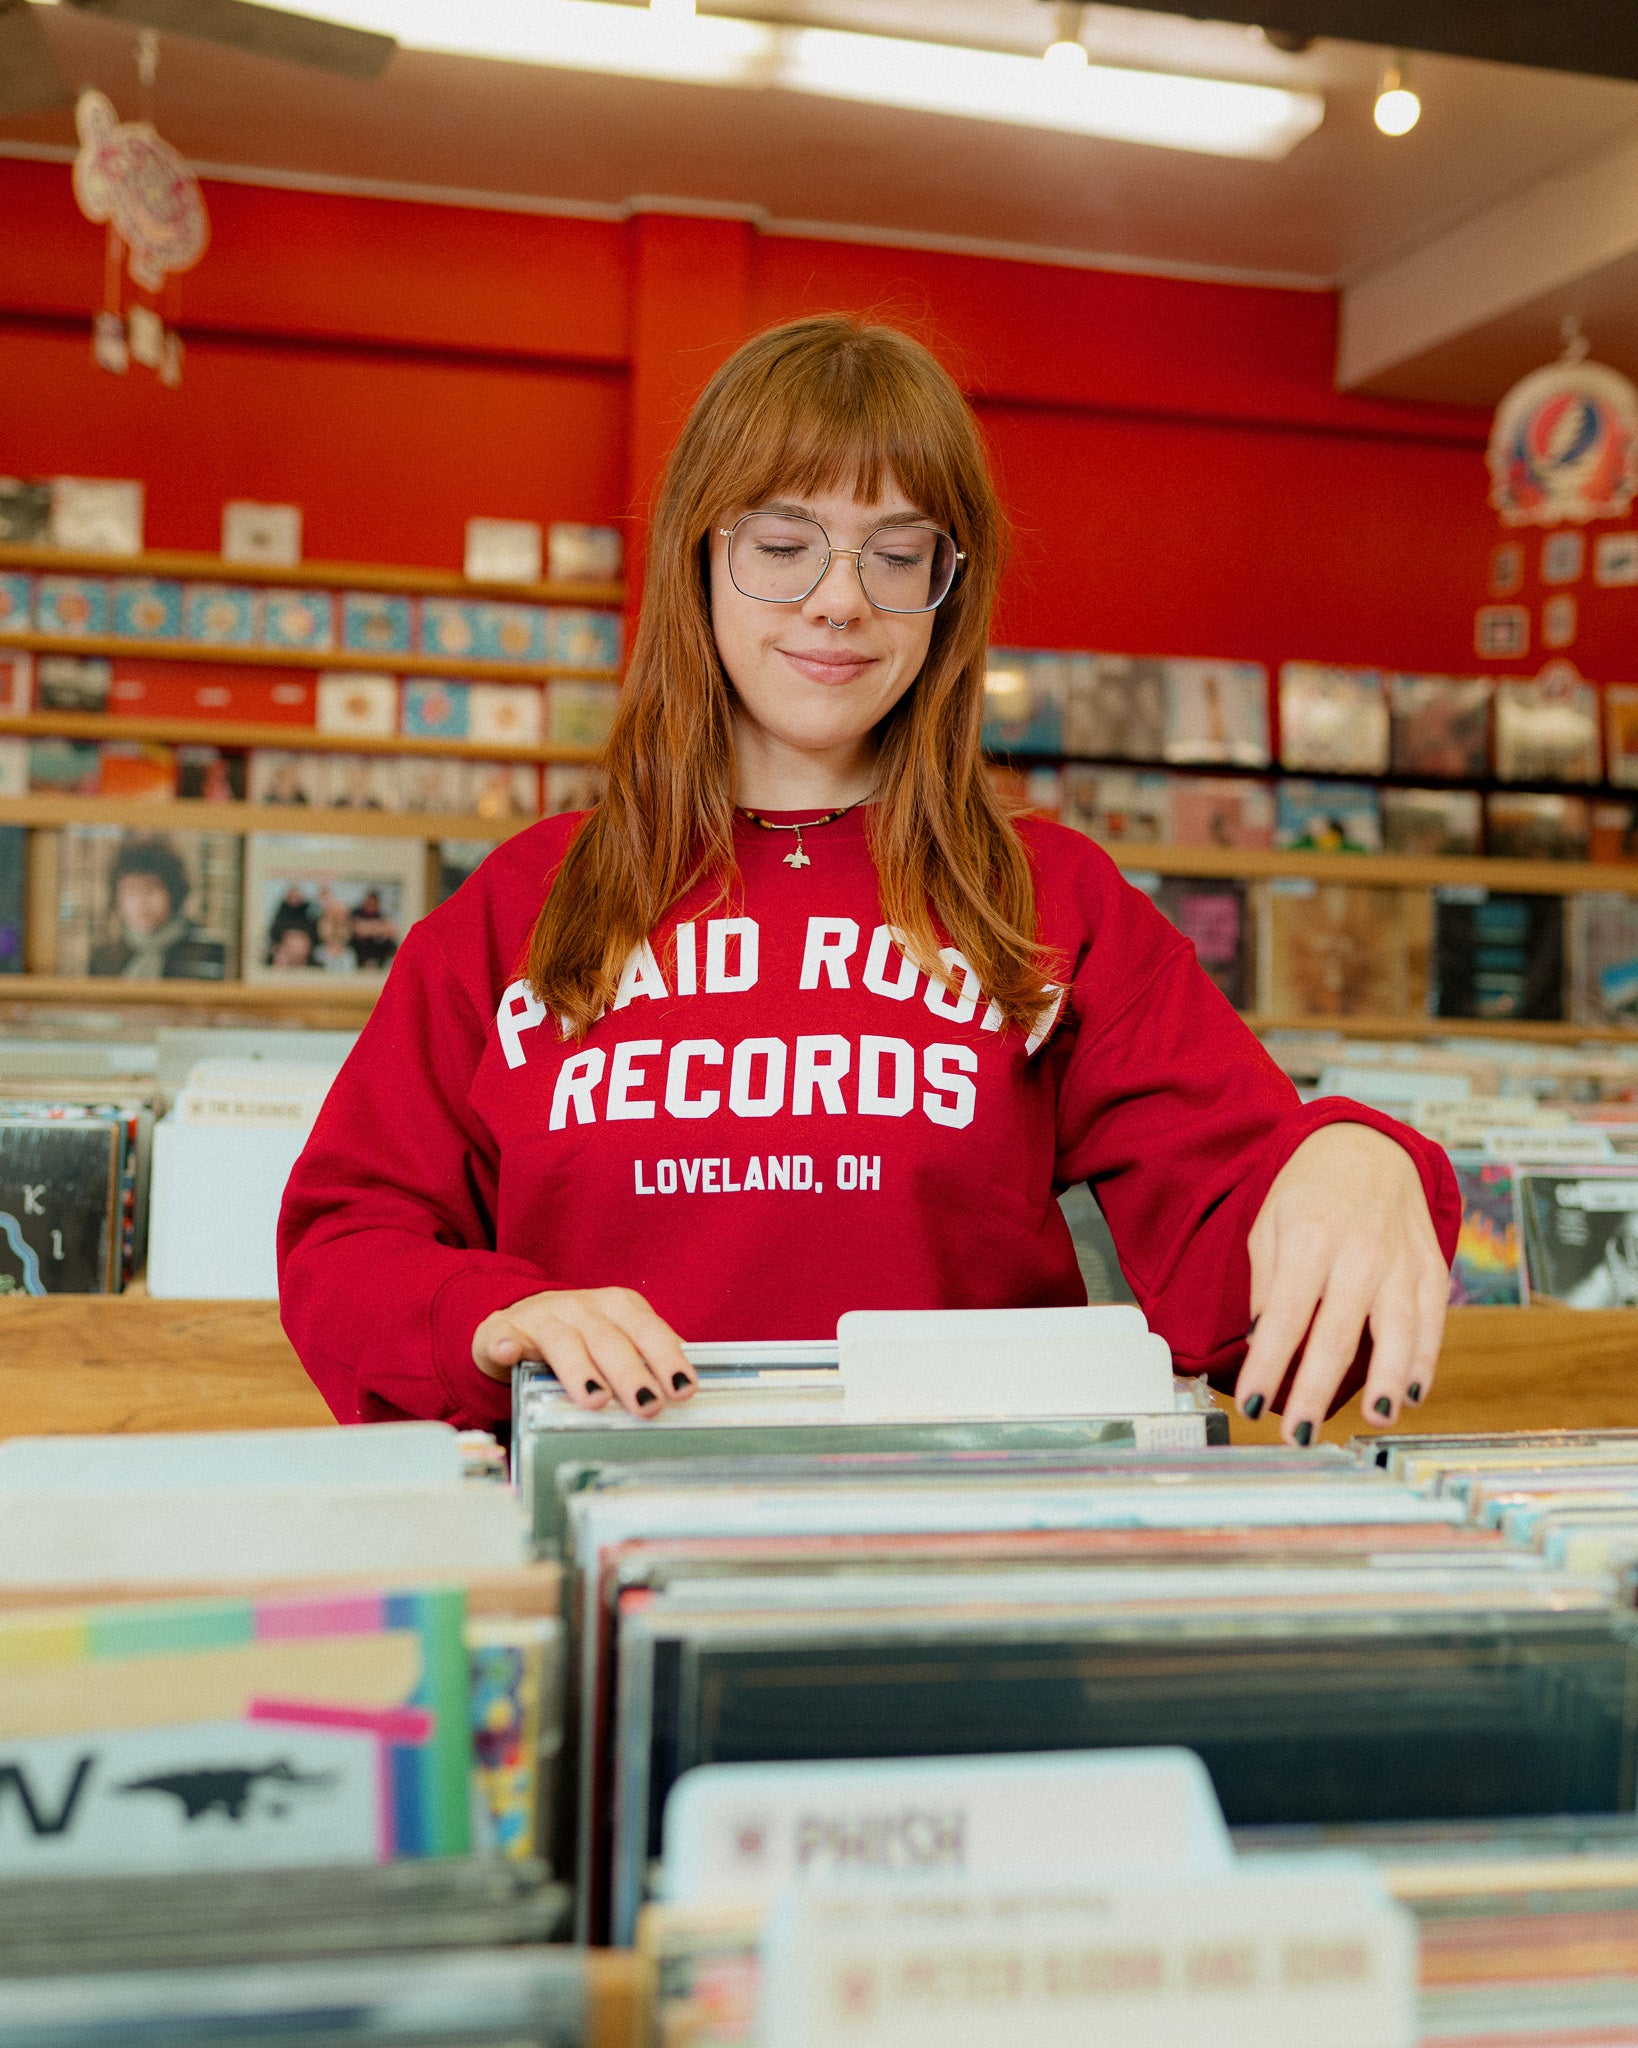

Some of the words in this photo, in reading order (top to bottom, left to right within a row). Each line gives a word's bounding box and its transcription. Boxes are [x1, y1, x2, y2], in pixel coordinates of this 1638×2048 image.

[497, 916, 759, 1070] PAID
[548, 1034, 978, 1130] RECORDS
[634, 1155, 823, 1195] LOVELAND,
[836, 1154, 881, 1191] OH
